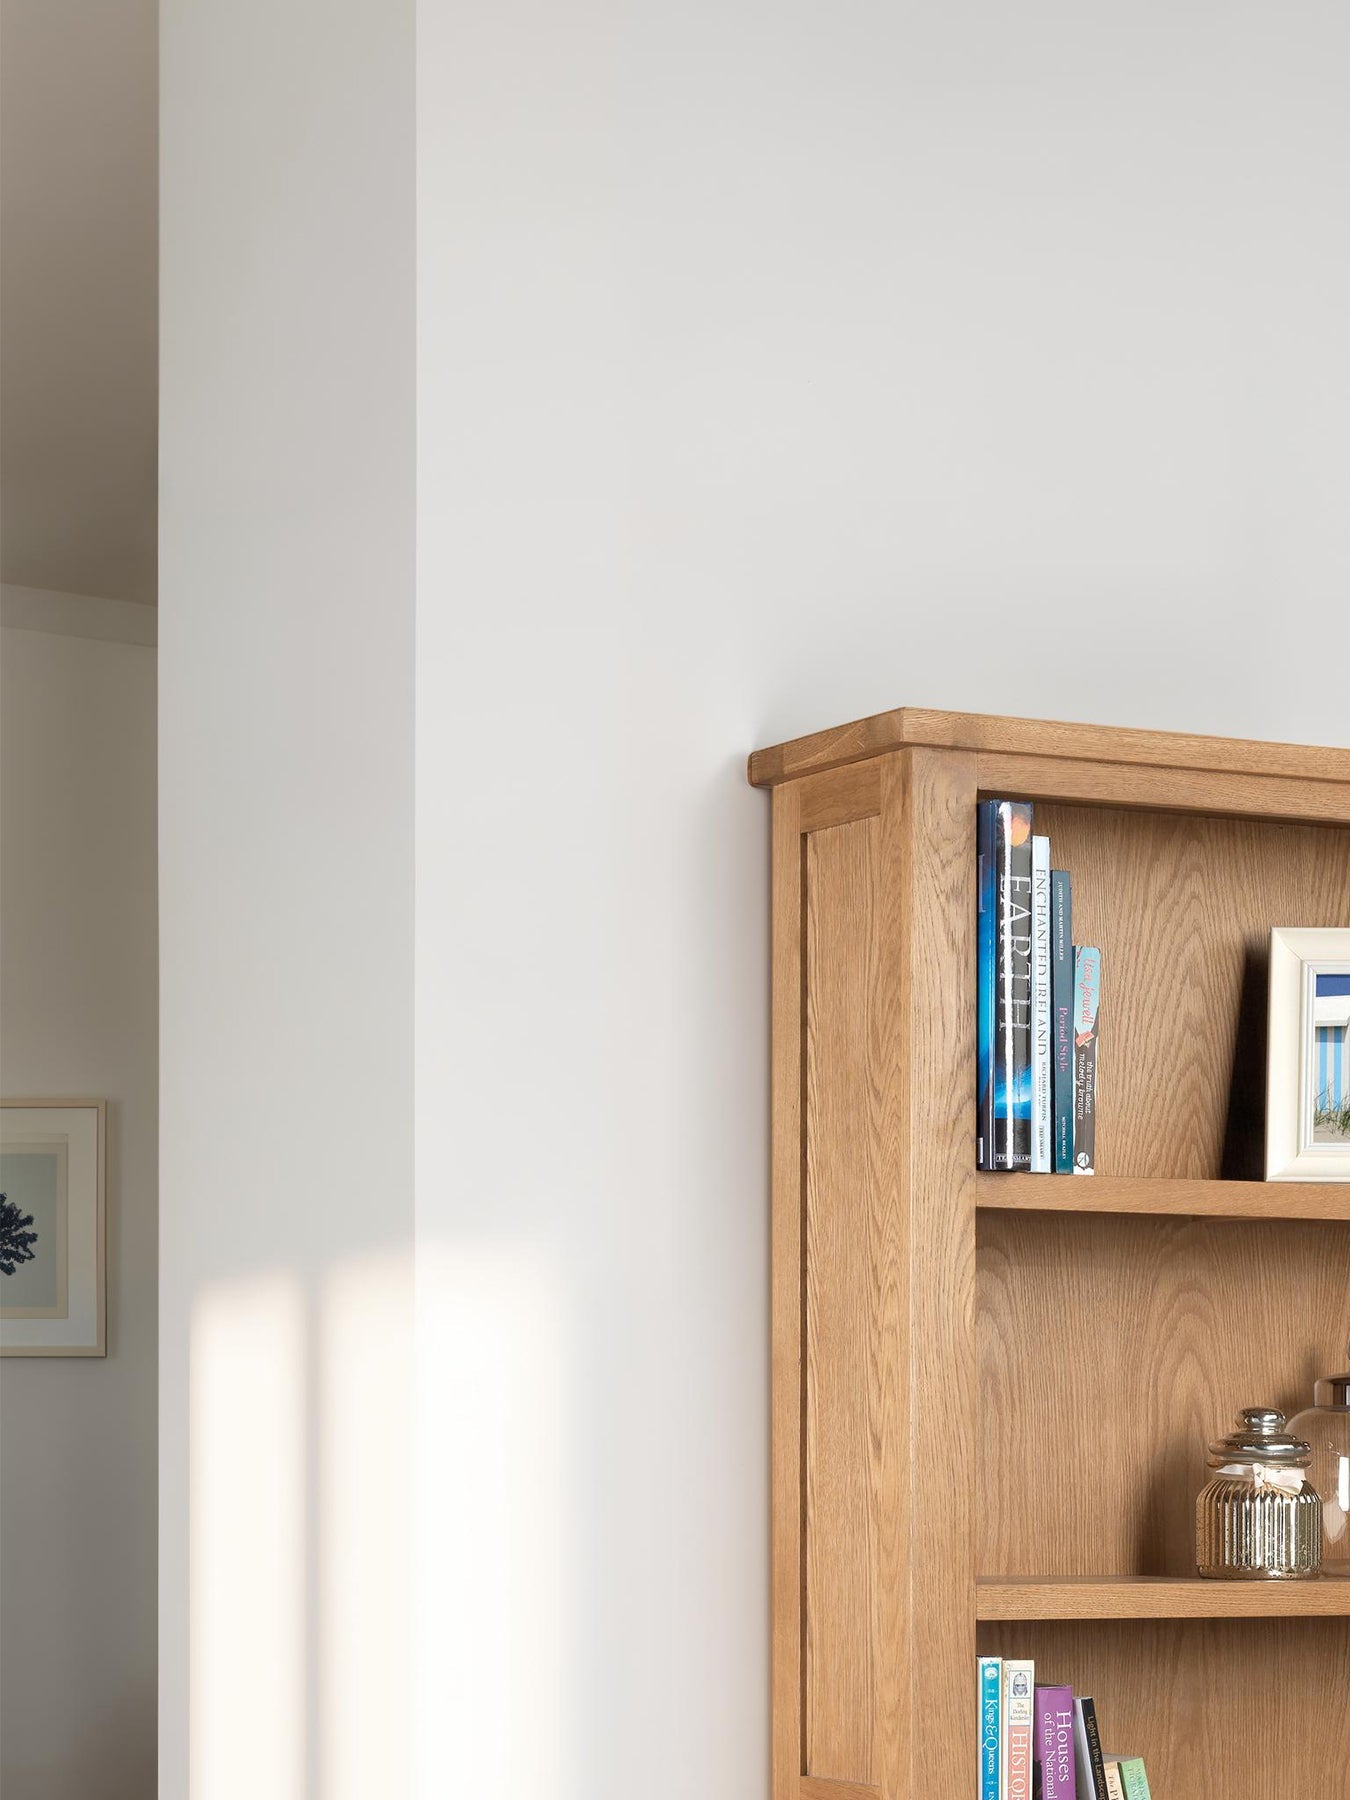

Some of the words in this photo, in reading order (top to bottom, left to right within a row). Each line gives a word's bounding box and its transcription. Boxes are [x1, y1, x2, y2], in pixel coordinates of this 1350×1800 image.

[1035, 869, 1047, 977] ENCHANTED
[1000, 873, 1031, 1032] EARTH
[1084, 958, 1096, 981] lisa
[1037, 982, 1047, 1055] IRELAND
[1078, 982, 1095, 1025] jewell
[1059, 1007, 1068, 1043] Period
[1057, 1045, 1068, 1072] Style
[1075, 1053, 1085, 1087] melody
[1085, 1074, 1093, 1092] truth
[1077, 1088, 1085, 1120] browne
[985, 1699, 998, 1724] Kings
[1043, 1712, 1055, 1726] of
[1087, 1715, 1096, 1737] Light
[985, 1725, 998, 1736] &
[1045, 1728, 1055, 1746] the
[1056, 1711, 1071, 1782] Houses
[983, 1736, 998, 1775] Queens
[1045, 1750, 1058, 1799] National
